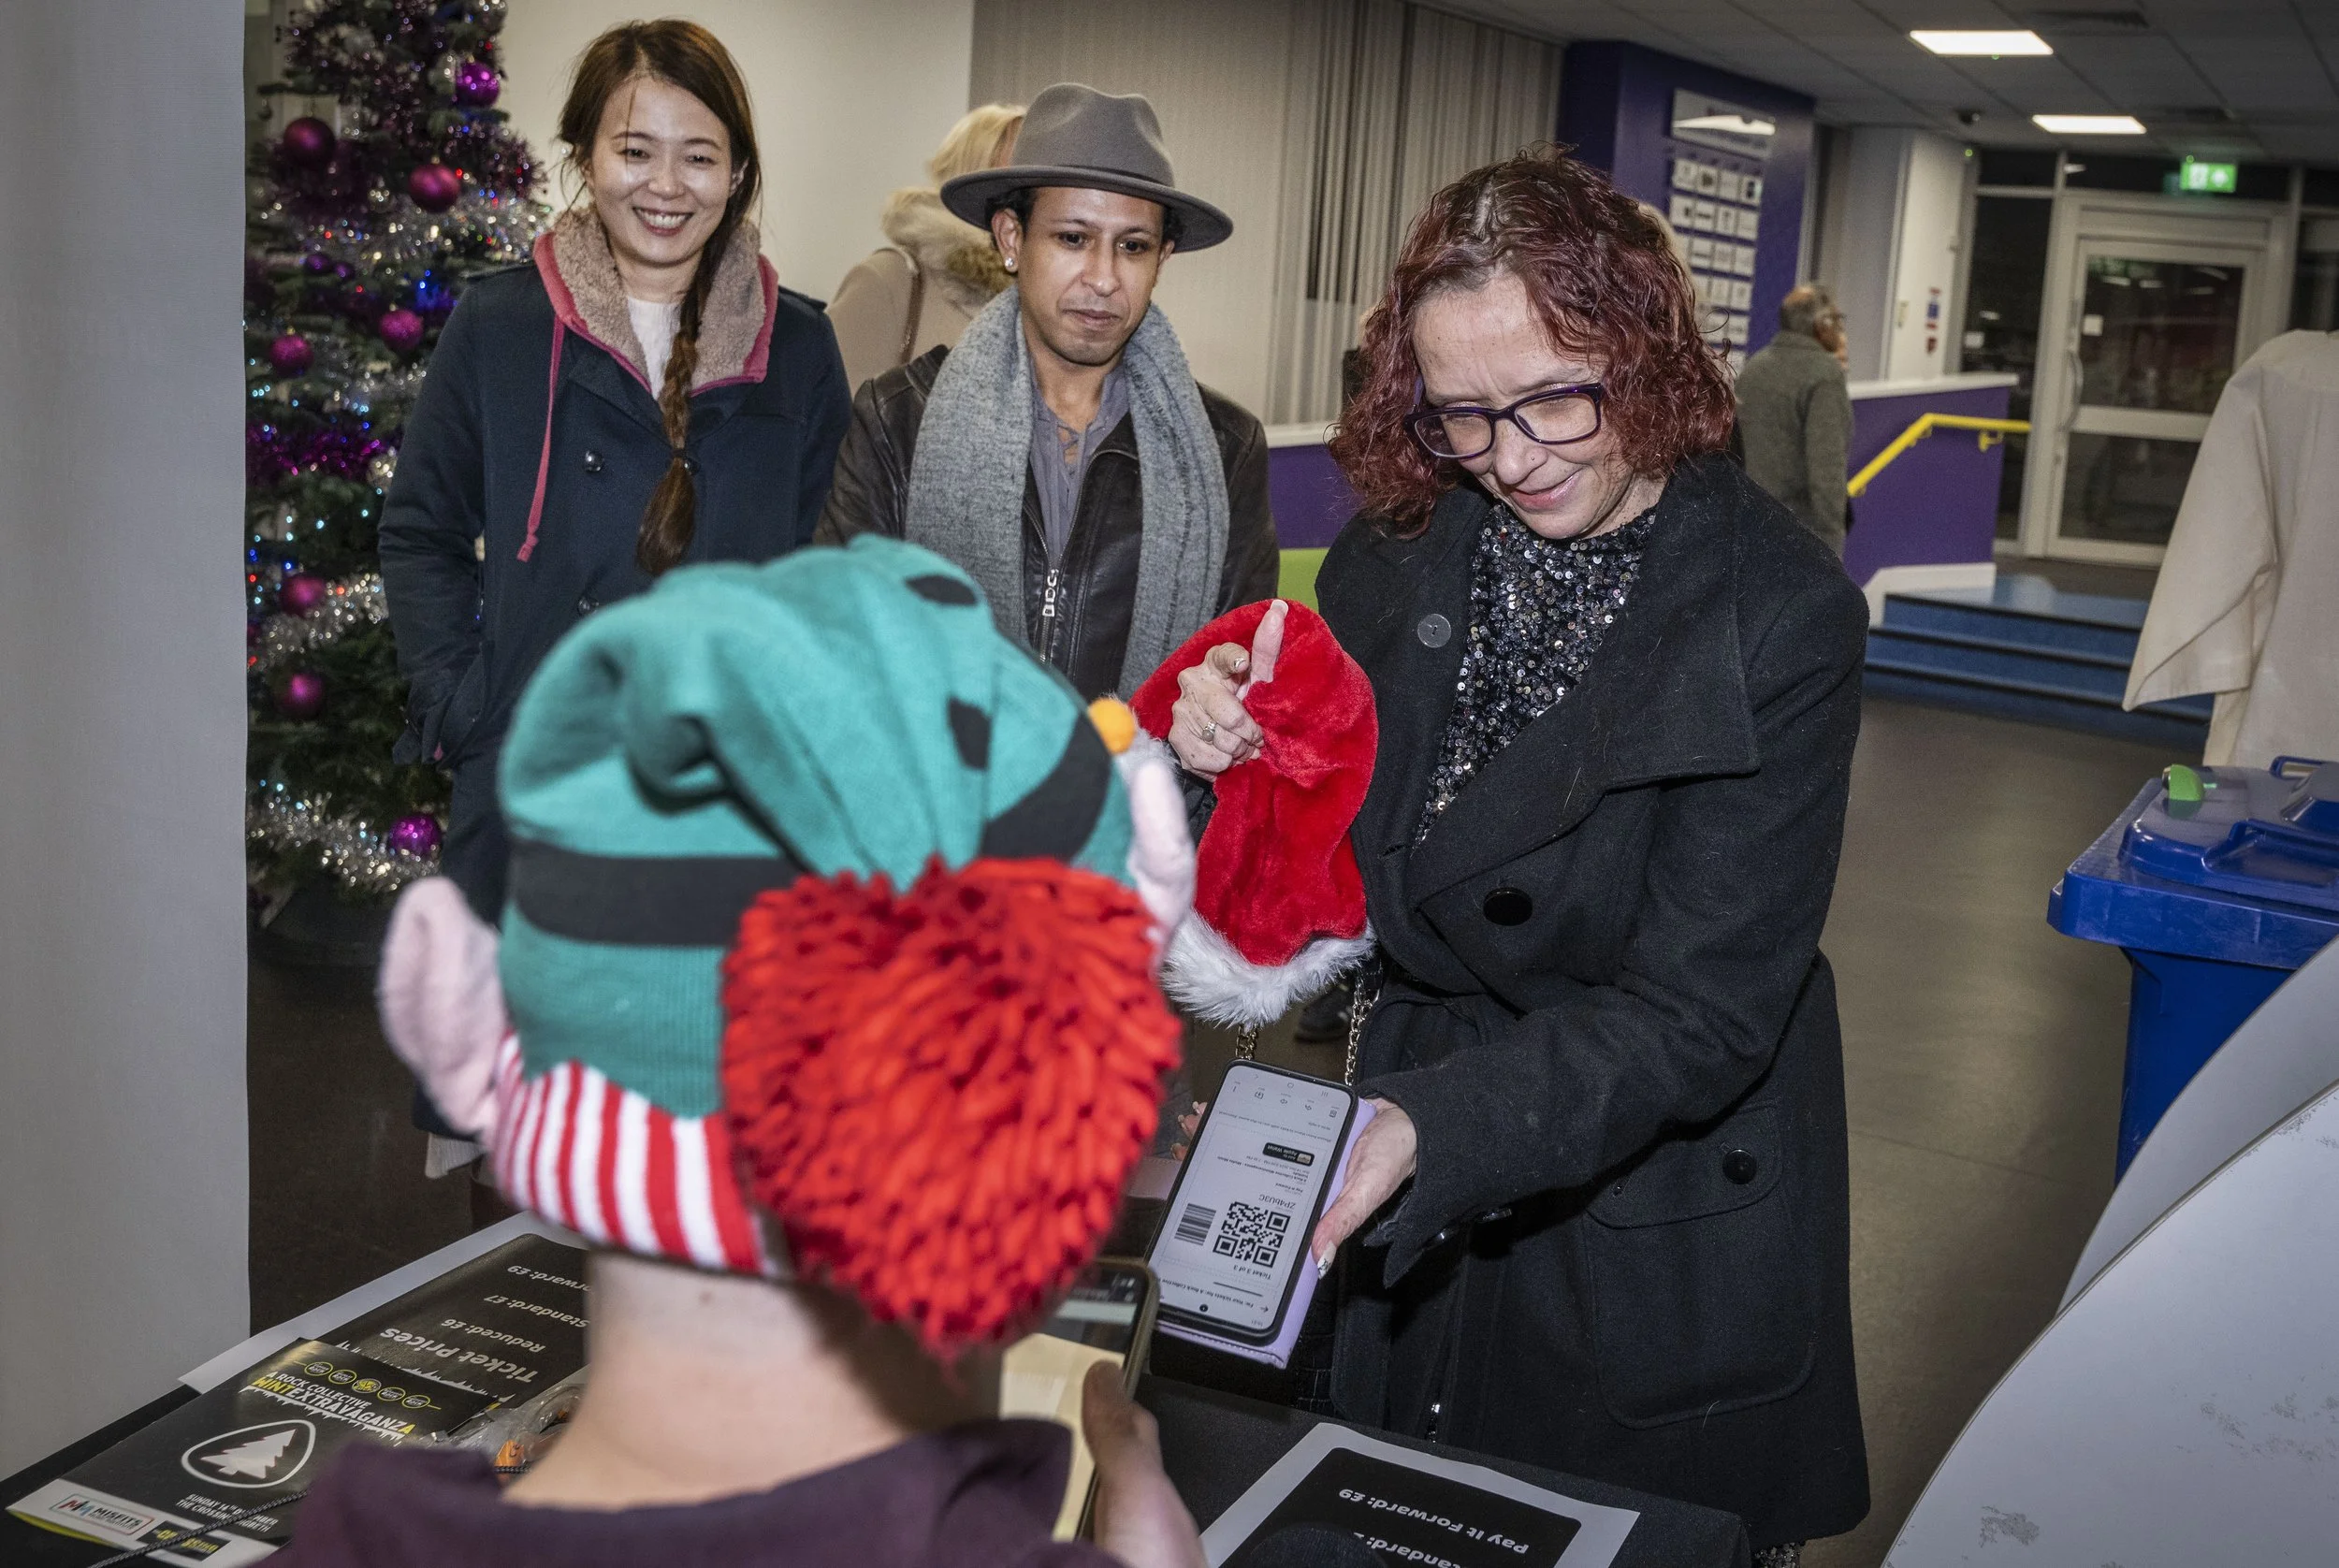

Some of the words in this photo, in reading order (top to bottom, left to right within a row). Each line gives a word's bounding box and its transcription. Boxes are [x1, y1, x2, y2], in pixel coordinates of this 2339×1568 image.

[1267, 1144, 1283, 1153] Wallet
[1282, 1148, 1298, 1156] Apple
[507, 1265, 531, 1276] £9
[1251, 1270, 1271, 1279] Ticket
[530, 1271, 592, 1293] orward:
[484, 1295, 509, 1305] £7
[506, 1299, 591, 1328] Standard:
[441, 1319, 467, 1329] £6
[380, 1328, 460, 1357] Prices
[465, 1325, 546, 1353] Reduced:
[458, 1351, 539, 1384] Ticket
[275, 1372, 310, 1387] ROCK
[306, 1384, 372, 1410] COLLECTIVE
[252, 1376, 417, 1435] WINTEXTRAVAGANZA
[175, 1499, 196, 1509] THE
[185, 1493, 222, 1508] SUNDAY
[1339, 1488, 1366, 1503] £9
[93, 1507, 143, 1527] MISFITS
[1367, 1497, 1463, 1532] Forward:
[1466, 1527, 1485, 1540] It
[1488, 1533, 1529, 1554] Pay
